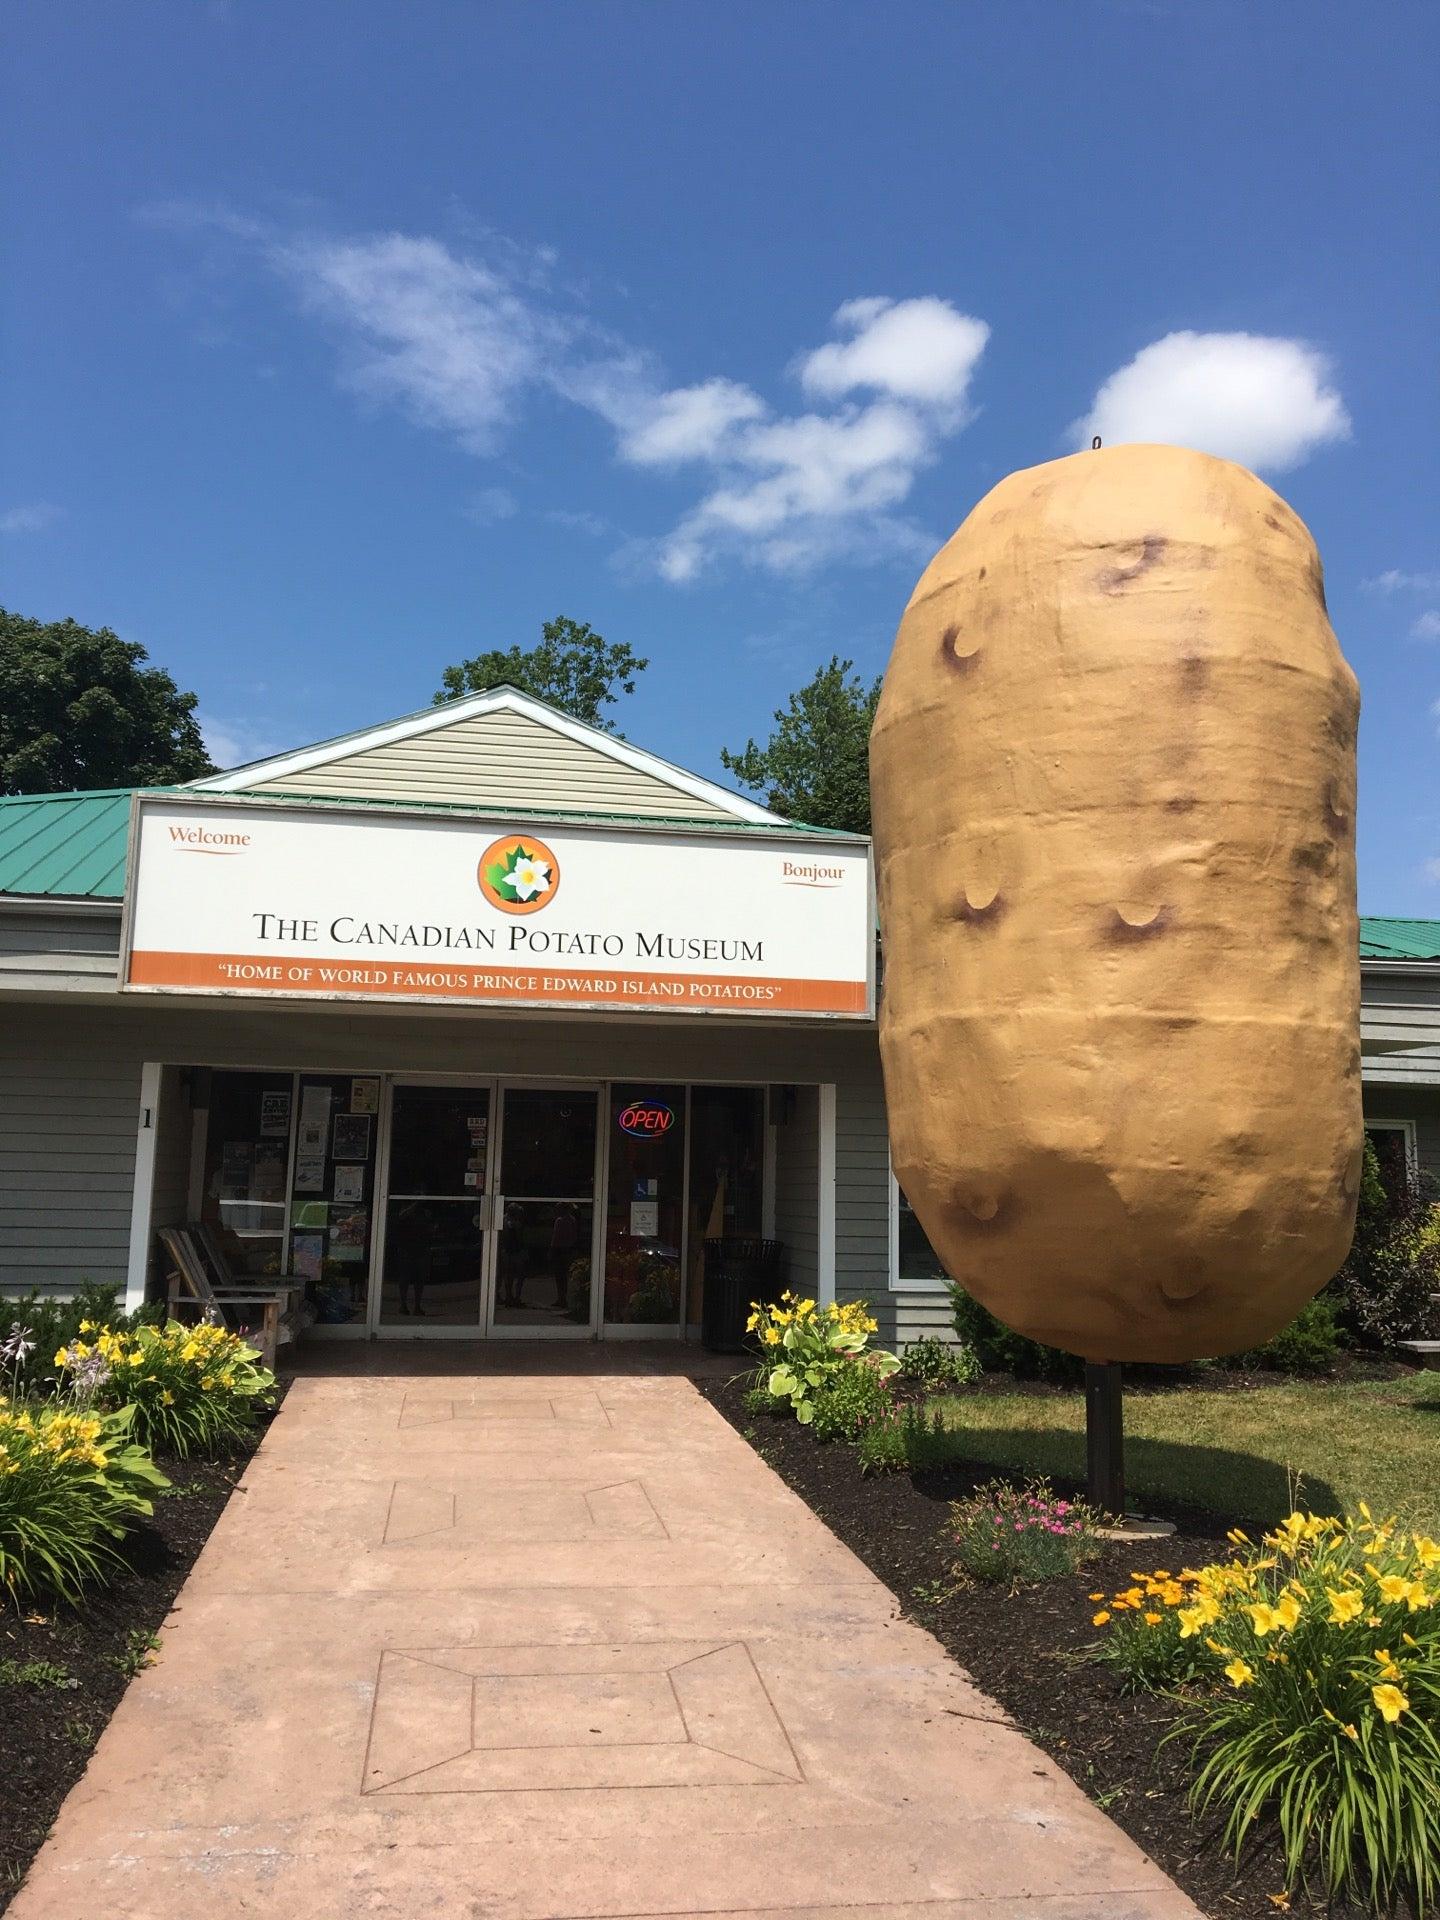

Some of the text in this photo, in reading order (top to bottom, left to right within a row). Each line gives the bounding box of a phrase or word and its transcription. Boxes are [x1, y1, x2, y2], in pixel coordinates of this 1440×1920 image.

[168, 826, 251, 846] Welcome
[782, 862, 845, 882] Bonjour
[330, 917, 496, 950] CANADIAN
[509, 926, 624, 956] POTATO
[636, 932, 763, 962] MUSEUM
[288, 967, 314, 982] OF
[319, 967, 387, 985] WORLD
[393, 971, 468, 989] FAMOUS
[473, 973, 538, 991] PRINCE
[542, 977, 617, 994] EDWARD
[622, 979, 685, 996] ISLAND
[622, 1110, 670, 1129] OPEN
